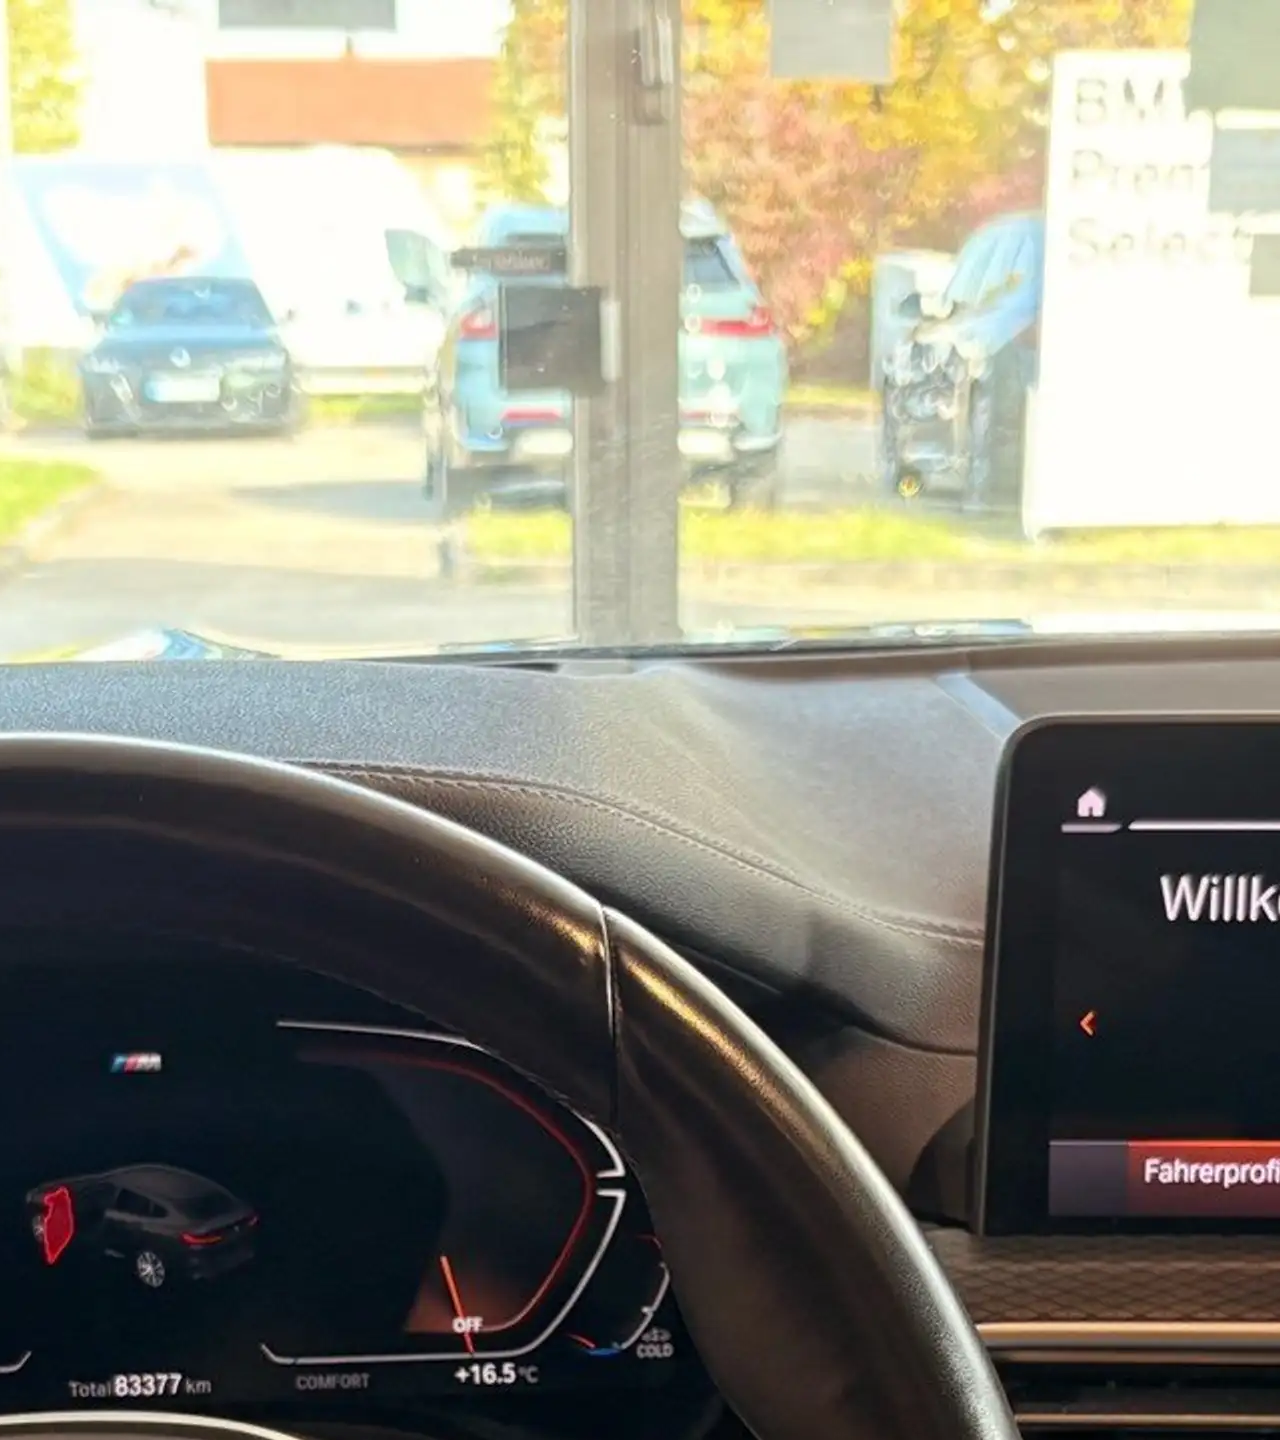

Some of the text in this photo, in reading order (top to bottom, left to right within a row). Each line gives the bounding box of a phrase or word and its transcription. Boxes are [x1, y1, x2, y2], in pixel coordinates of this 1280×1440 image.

[452, 1316, 483, 1333] OFF
[636, 1342, 674, 1358] COLD
[69, 1372, 212, 1398] Total 83377 km
[296, 1373, 370, 1391] COMFORT
